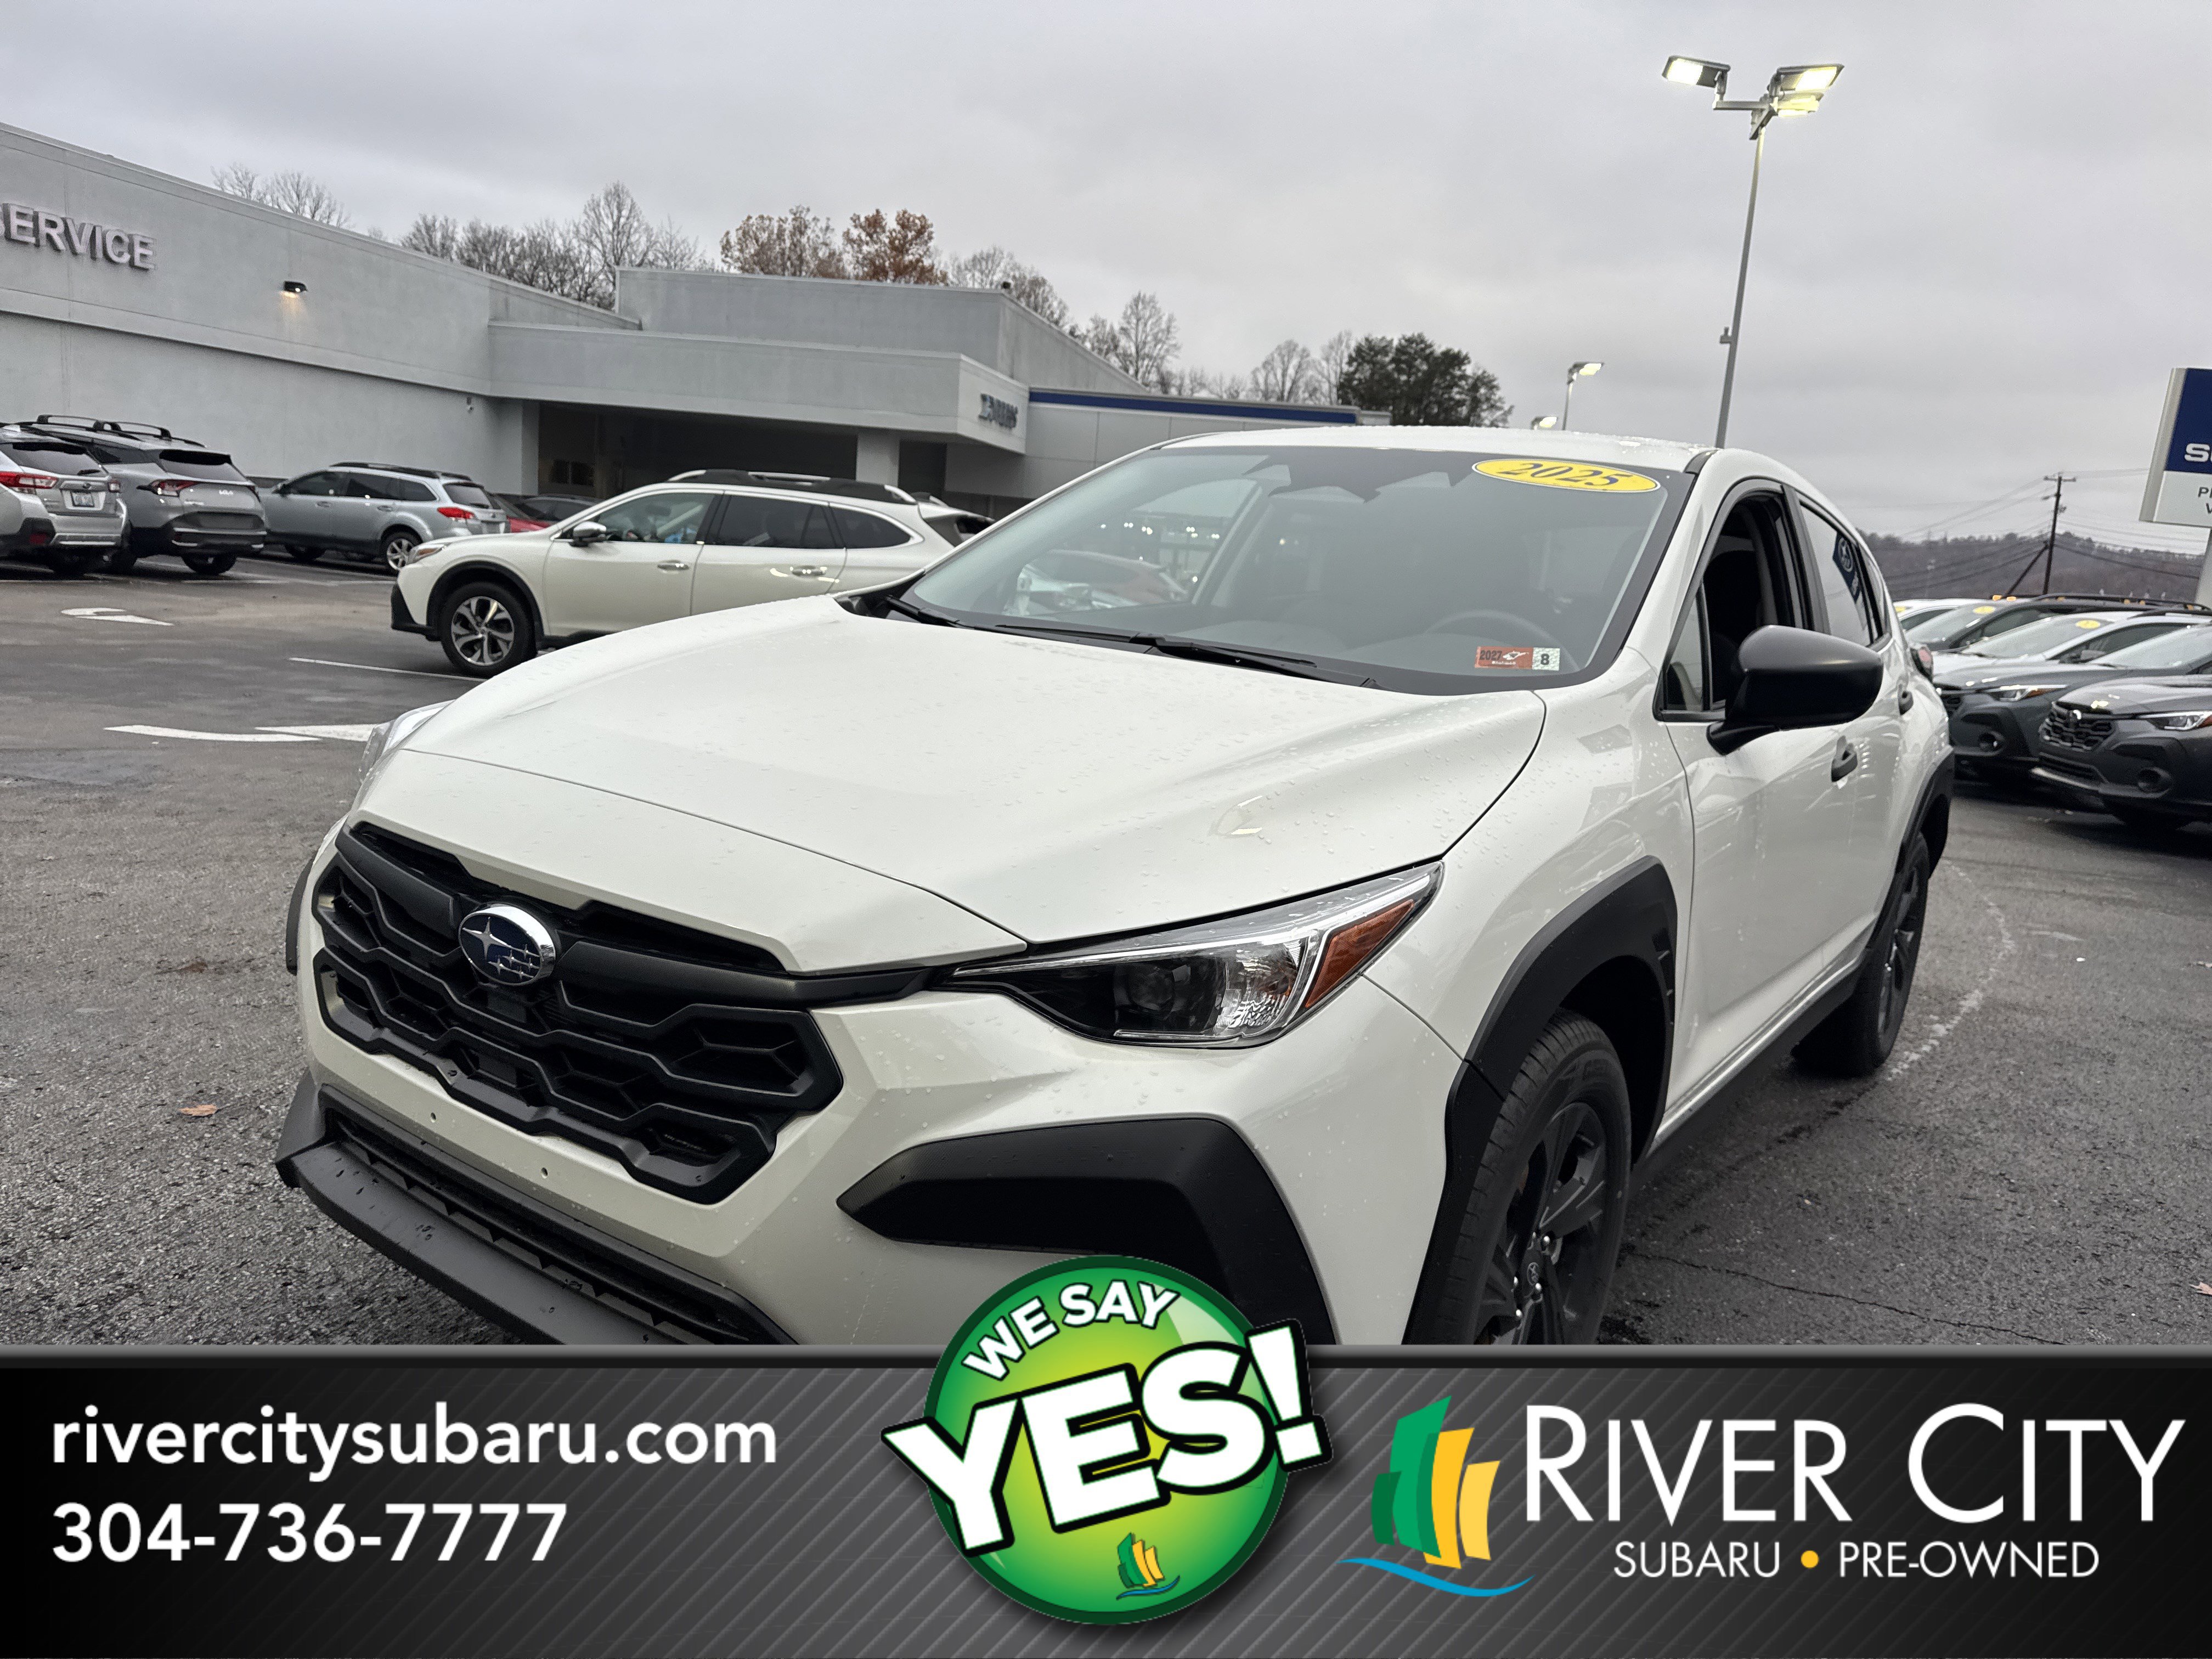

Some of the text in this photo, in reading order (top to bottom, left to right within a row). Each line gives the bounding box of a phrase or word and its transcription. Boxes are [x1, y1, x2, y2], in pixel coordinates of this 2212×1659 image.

[0, 203, 155, 269] ERVICE
[2184, 443, 2212, 462] S
[1496, 462, 1634, 487] 2025
[2198, 486, 2212, 499] P
[1479, 650, 1503, 661] 2027
[1541, 653, 1550, 665] 8
